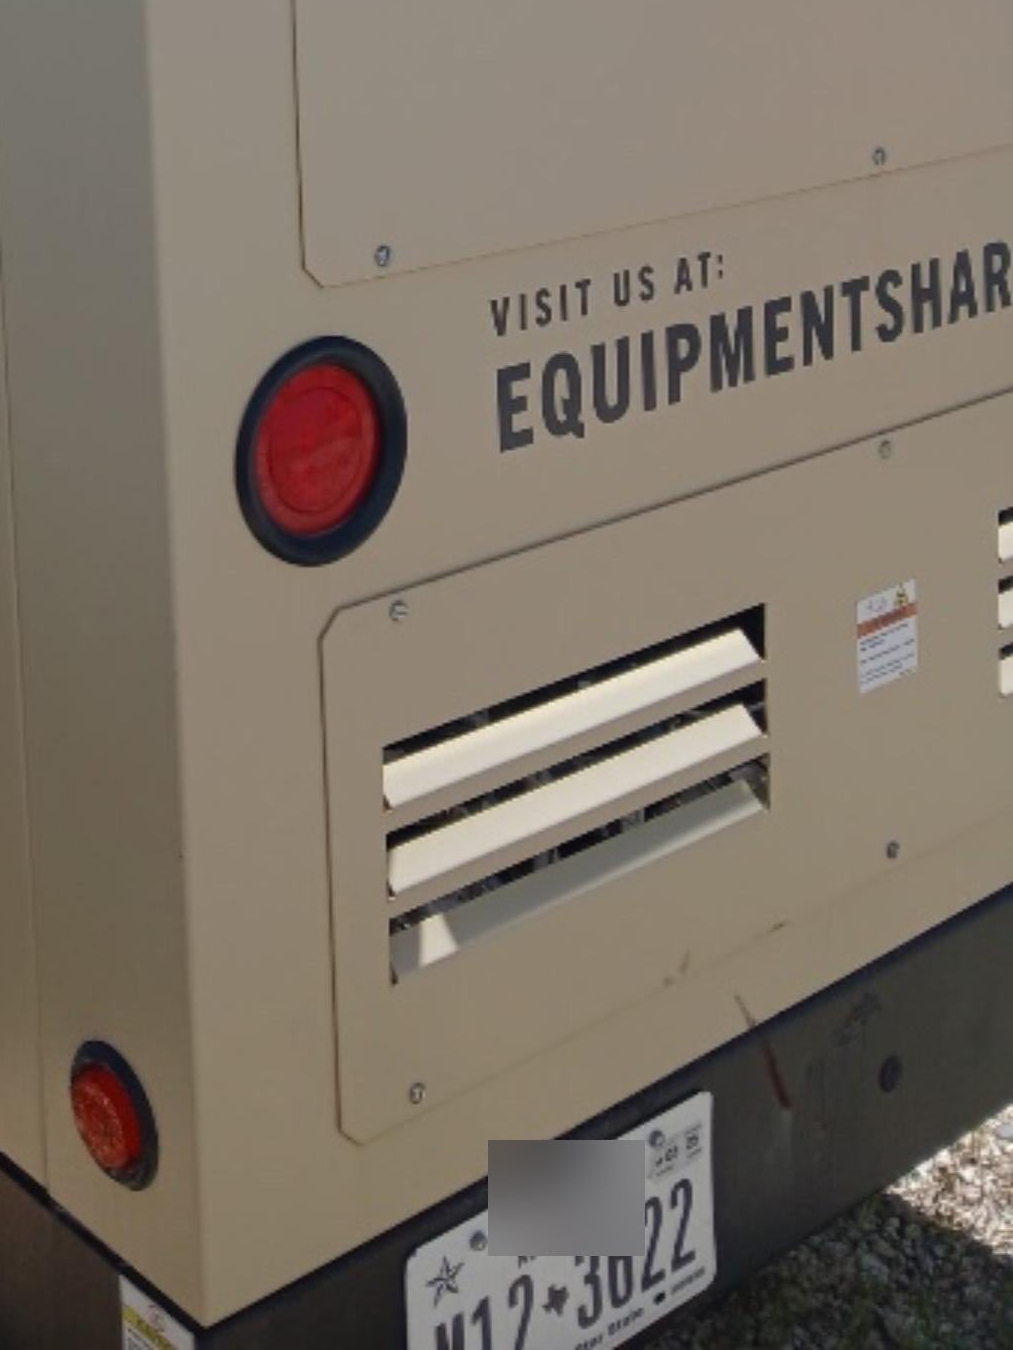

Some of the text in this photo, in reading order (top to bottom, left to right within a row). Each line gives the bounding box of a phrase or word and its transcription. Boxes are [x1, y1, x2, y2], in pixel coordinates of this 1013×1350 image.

[489, 252, 724, 336] VISIT US AT:
